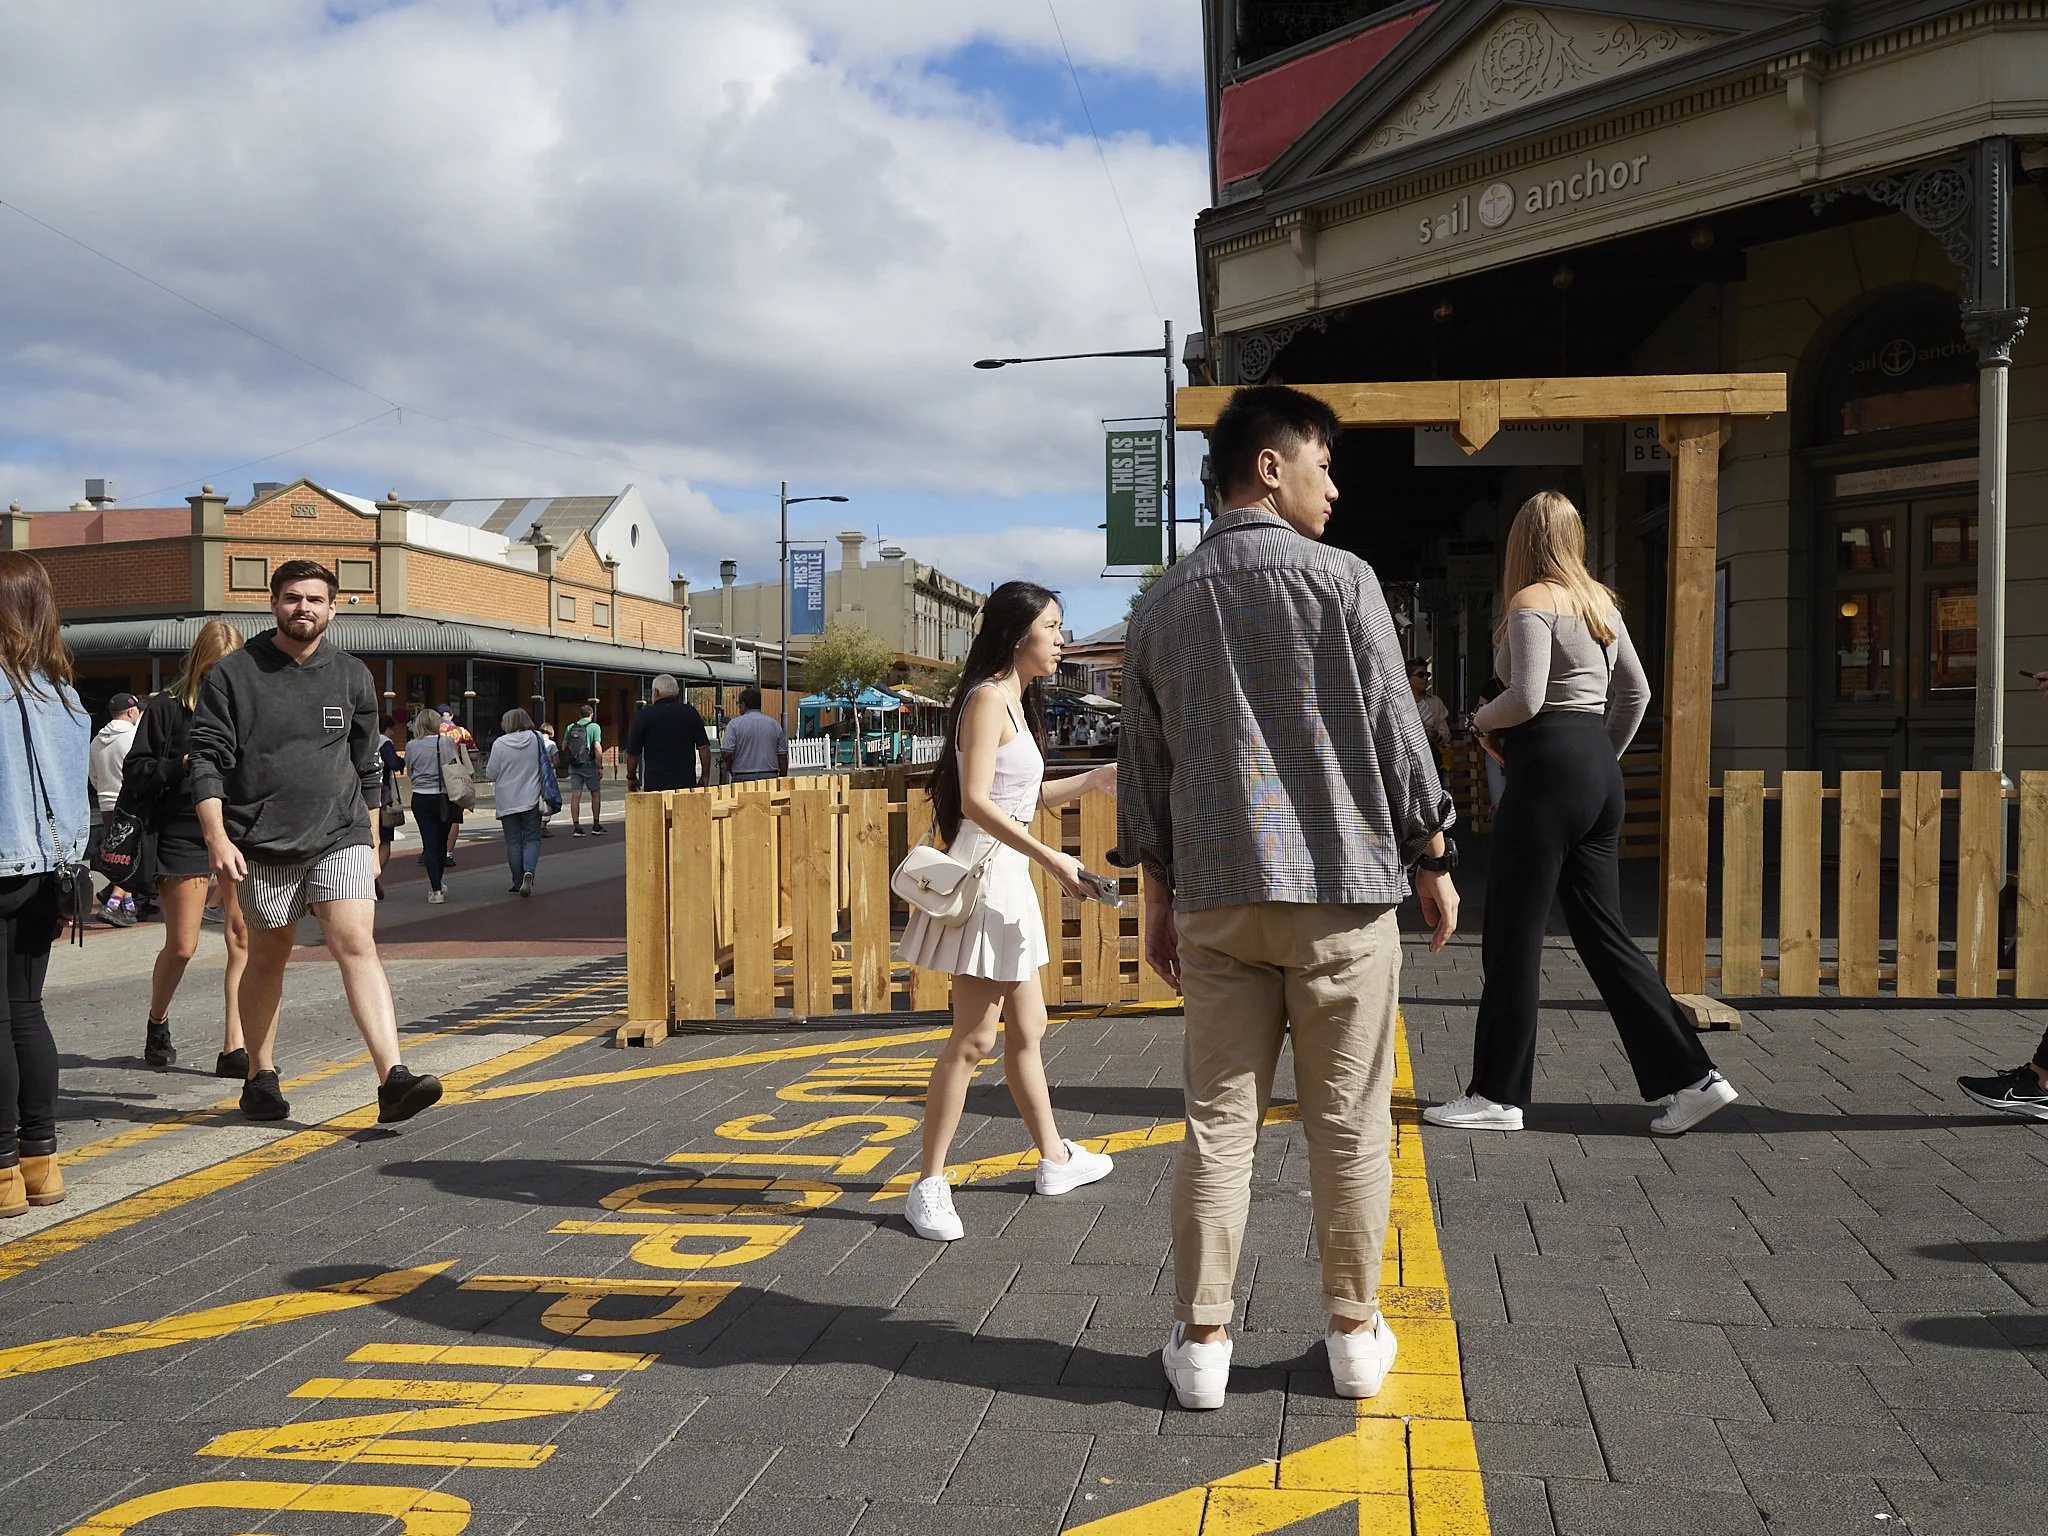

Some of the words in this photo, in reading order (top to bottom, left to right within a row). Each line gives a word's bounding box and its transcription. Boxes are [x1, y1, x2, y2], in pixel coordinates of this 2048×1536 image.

[1419, 195, 1470, 244] sail
[1524, 155, 1649, 213] anchor
[1848, 353, 1876, 374] sail
[1918, 341, 1977, 362] ancho
[1111, 437, 1134, 454] IS
[1634, 427, 1659, 439] CR
[1111, 458, 1134, 494] THIS
[1134, 436, 1157, 527] FREMANTLE
[291, 505, 316, 516] 1990
[793, 553, 808, 564] IS
[793, 566, 808, 590] THIS
[807, 552, 822, 611] FREMANTLE
[775, 1057, 998, 1103] NO
